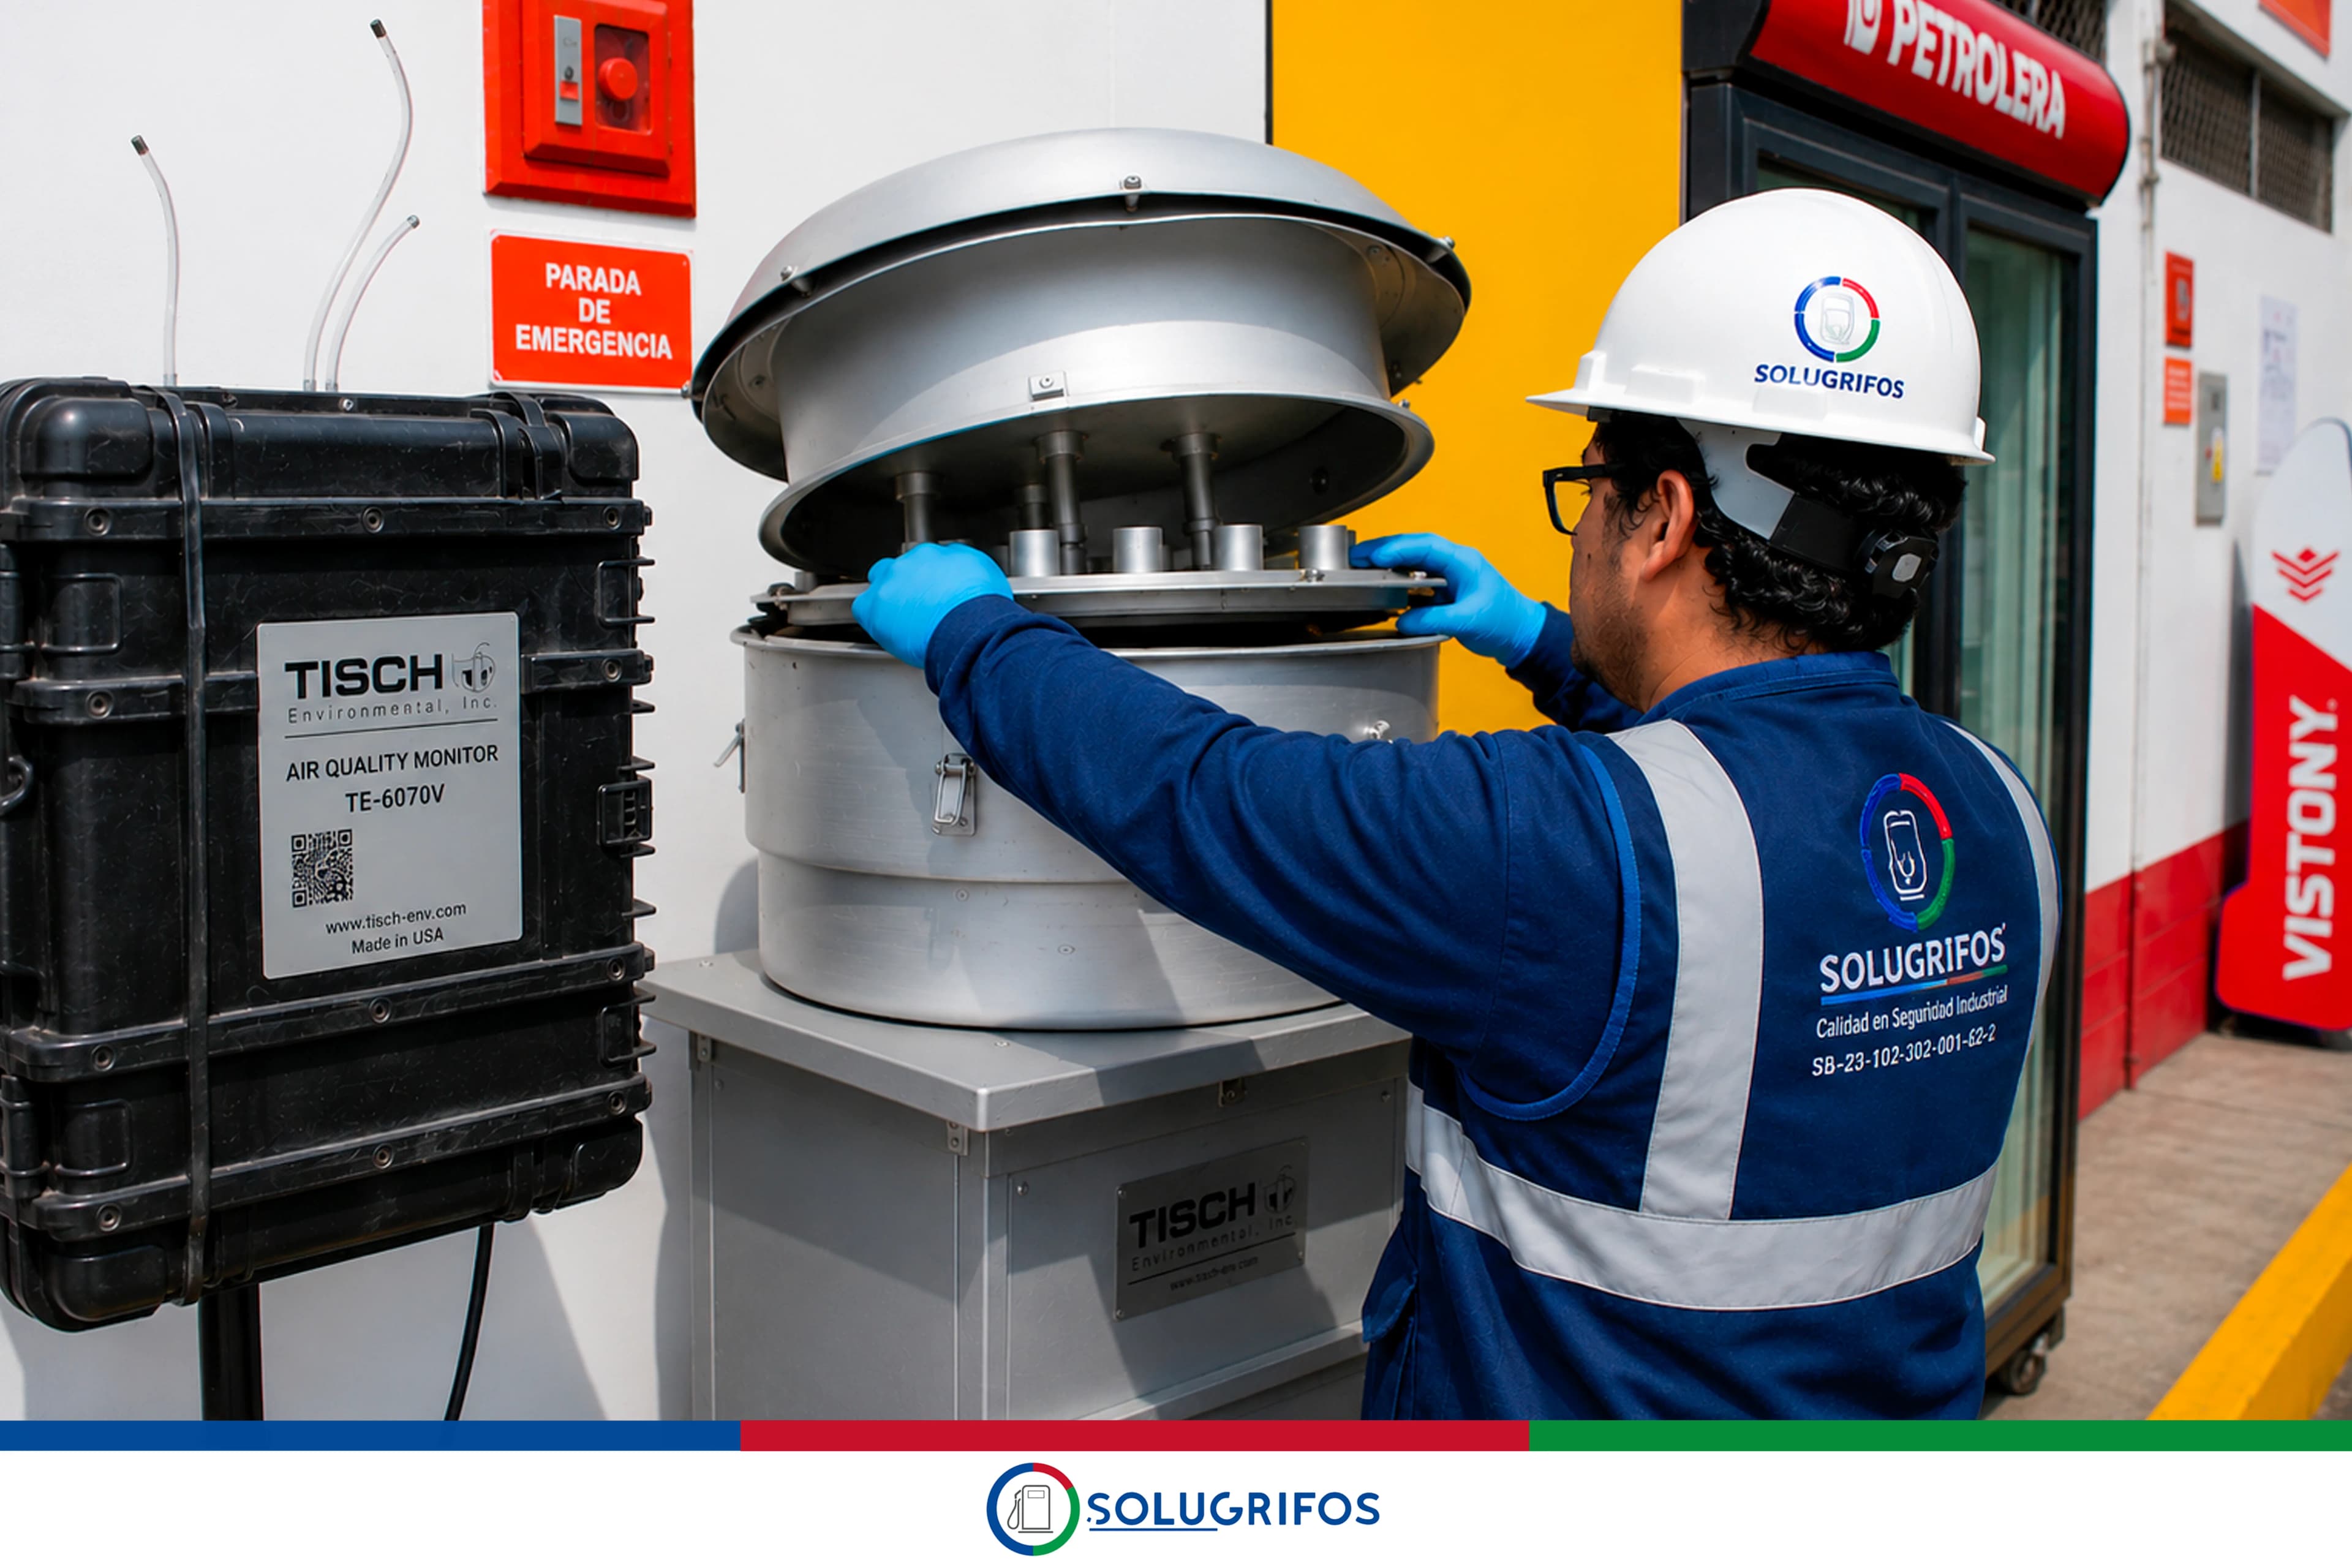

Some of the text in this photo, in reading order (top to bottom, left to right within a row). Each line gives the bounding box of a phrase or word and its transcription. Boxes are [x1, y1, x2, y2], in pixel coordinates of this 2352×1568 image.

[1887, 0, 2066, 139] PETROLERA
[545, 263, 642, 296] PARADA
[579, 297, 611, 325] DE
[515, 324, 673, 360] EMERGENCIA
[1754, 364, 1904, 399] SOLUGRIFOS
[285, 654, 443, 699] TISCH
[288, 696, 497, 724] Environmental, Inc.
[286, 744, 499, 782] AIR QUALITY MONITOR
[345, 783, 445, 813] TE-6070V
[326, 903, 467, 935] www.tisch-env.com
[352, 928, 444, 955] Made in USA
[1820, 925, 2006, 993] SOLUGRIFOS
[1817, 985, 2008, 1039] Calidad en Seguridad Industrial
[1129, 1182, 1255, 1249] TISCH
